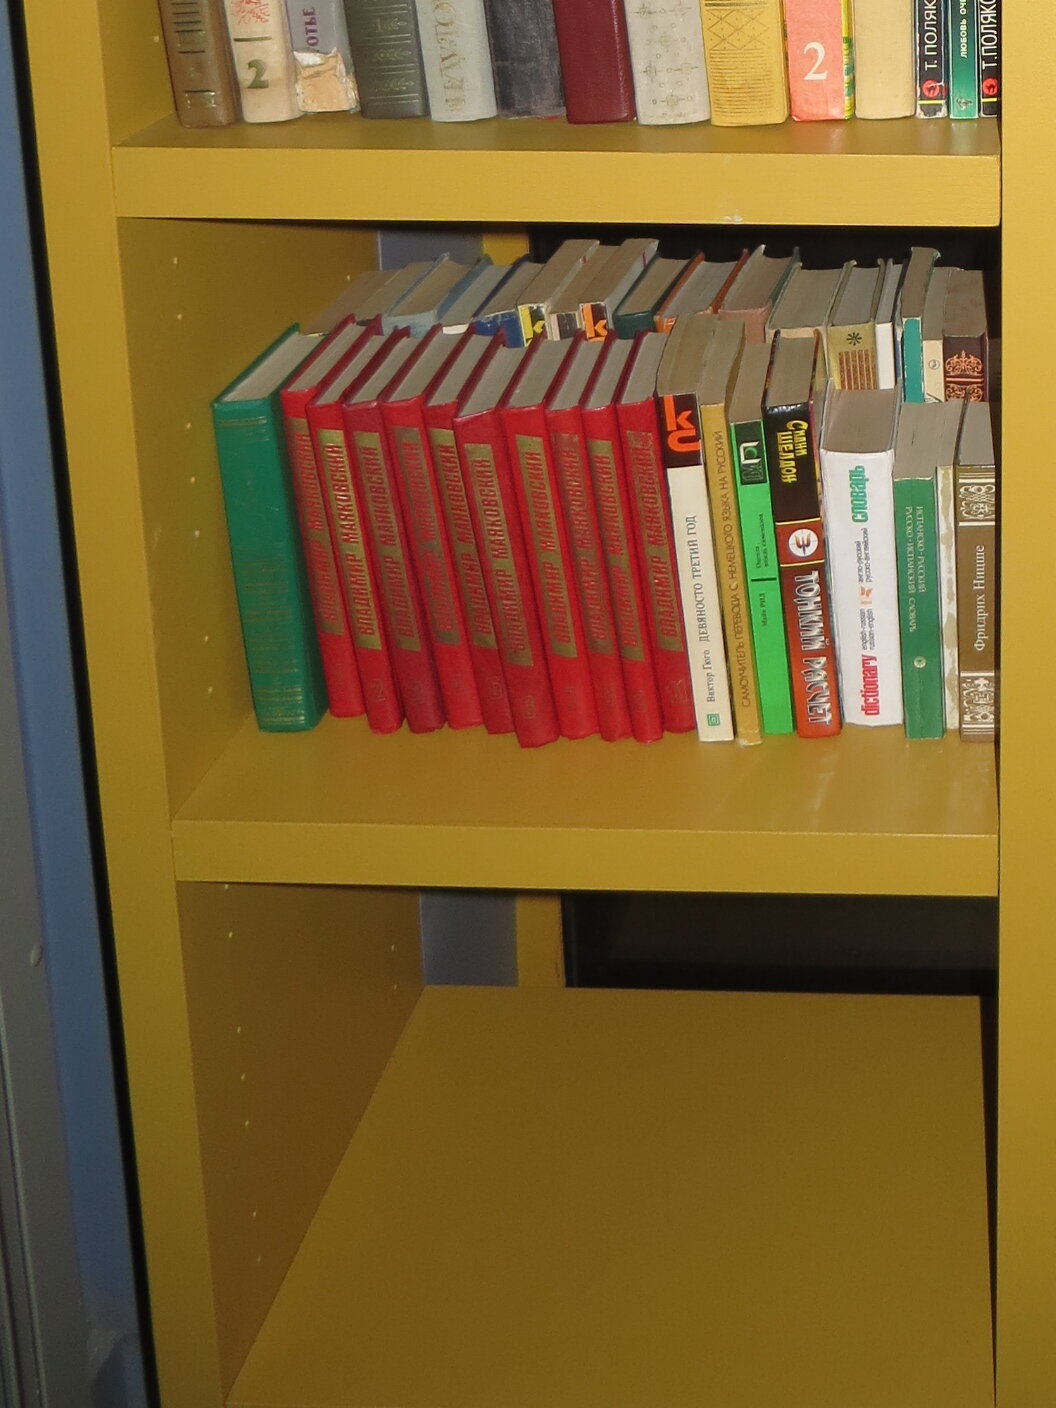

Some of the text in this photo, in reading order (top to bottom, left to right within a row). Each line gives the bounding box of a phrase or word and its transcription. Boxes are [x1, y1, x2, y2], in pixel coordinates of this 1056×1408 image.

[802, 41, 829, 82] 2
[925, 59, 938, 71] Т.
[958, 18, 969, 59] ЛЮБОВЬ
[245, 58, 270, 90] 2
[711, 430, 727, 475] РУССКИЙ
[718, 477, 729, 490] НА
[719, 492, 733, 522] ЯЗЫКА
[323, 445, 376, 635] ВЛАДИМИР МАЯКОВСКИЙ
[359, 446, 414, 638] ВЛАДИМИР МАЯКОВСКИЙ
[436, 445, 491, 635] ВЛАДИМИР МАЯКОВСКИЙ
[473, 459, 526, 652] ВЛАДИМИР МАЯКОВСКИЙ
[524, 451, 572, 643] ВЛАДИМИР МАЯКОВСКИЙ
[629, 444, 679, 638] ВЛАДИМИР МАЯКОВСКИЙ
[722, 524, 739, 580] НЕМЕЦКОГО
[684, 515, 717, 703] Виктор Гюго ДЕВЯНОСТО ТРЕТИЙ ГОД
[729, 593, 745, 640] ПЕРЕВОДА
[970, 543, 988, 652] Фридрих Ницше
[737, 641, 751, 708] САМОУЧИТЕЛЬ
[792, 570, 832, 725] ТОНКИЙ РАСЧЕТ
[859, 654, 880, 716] dictionary
